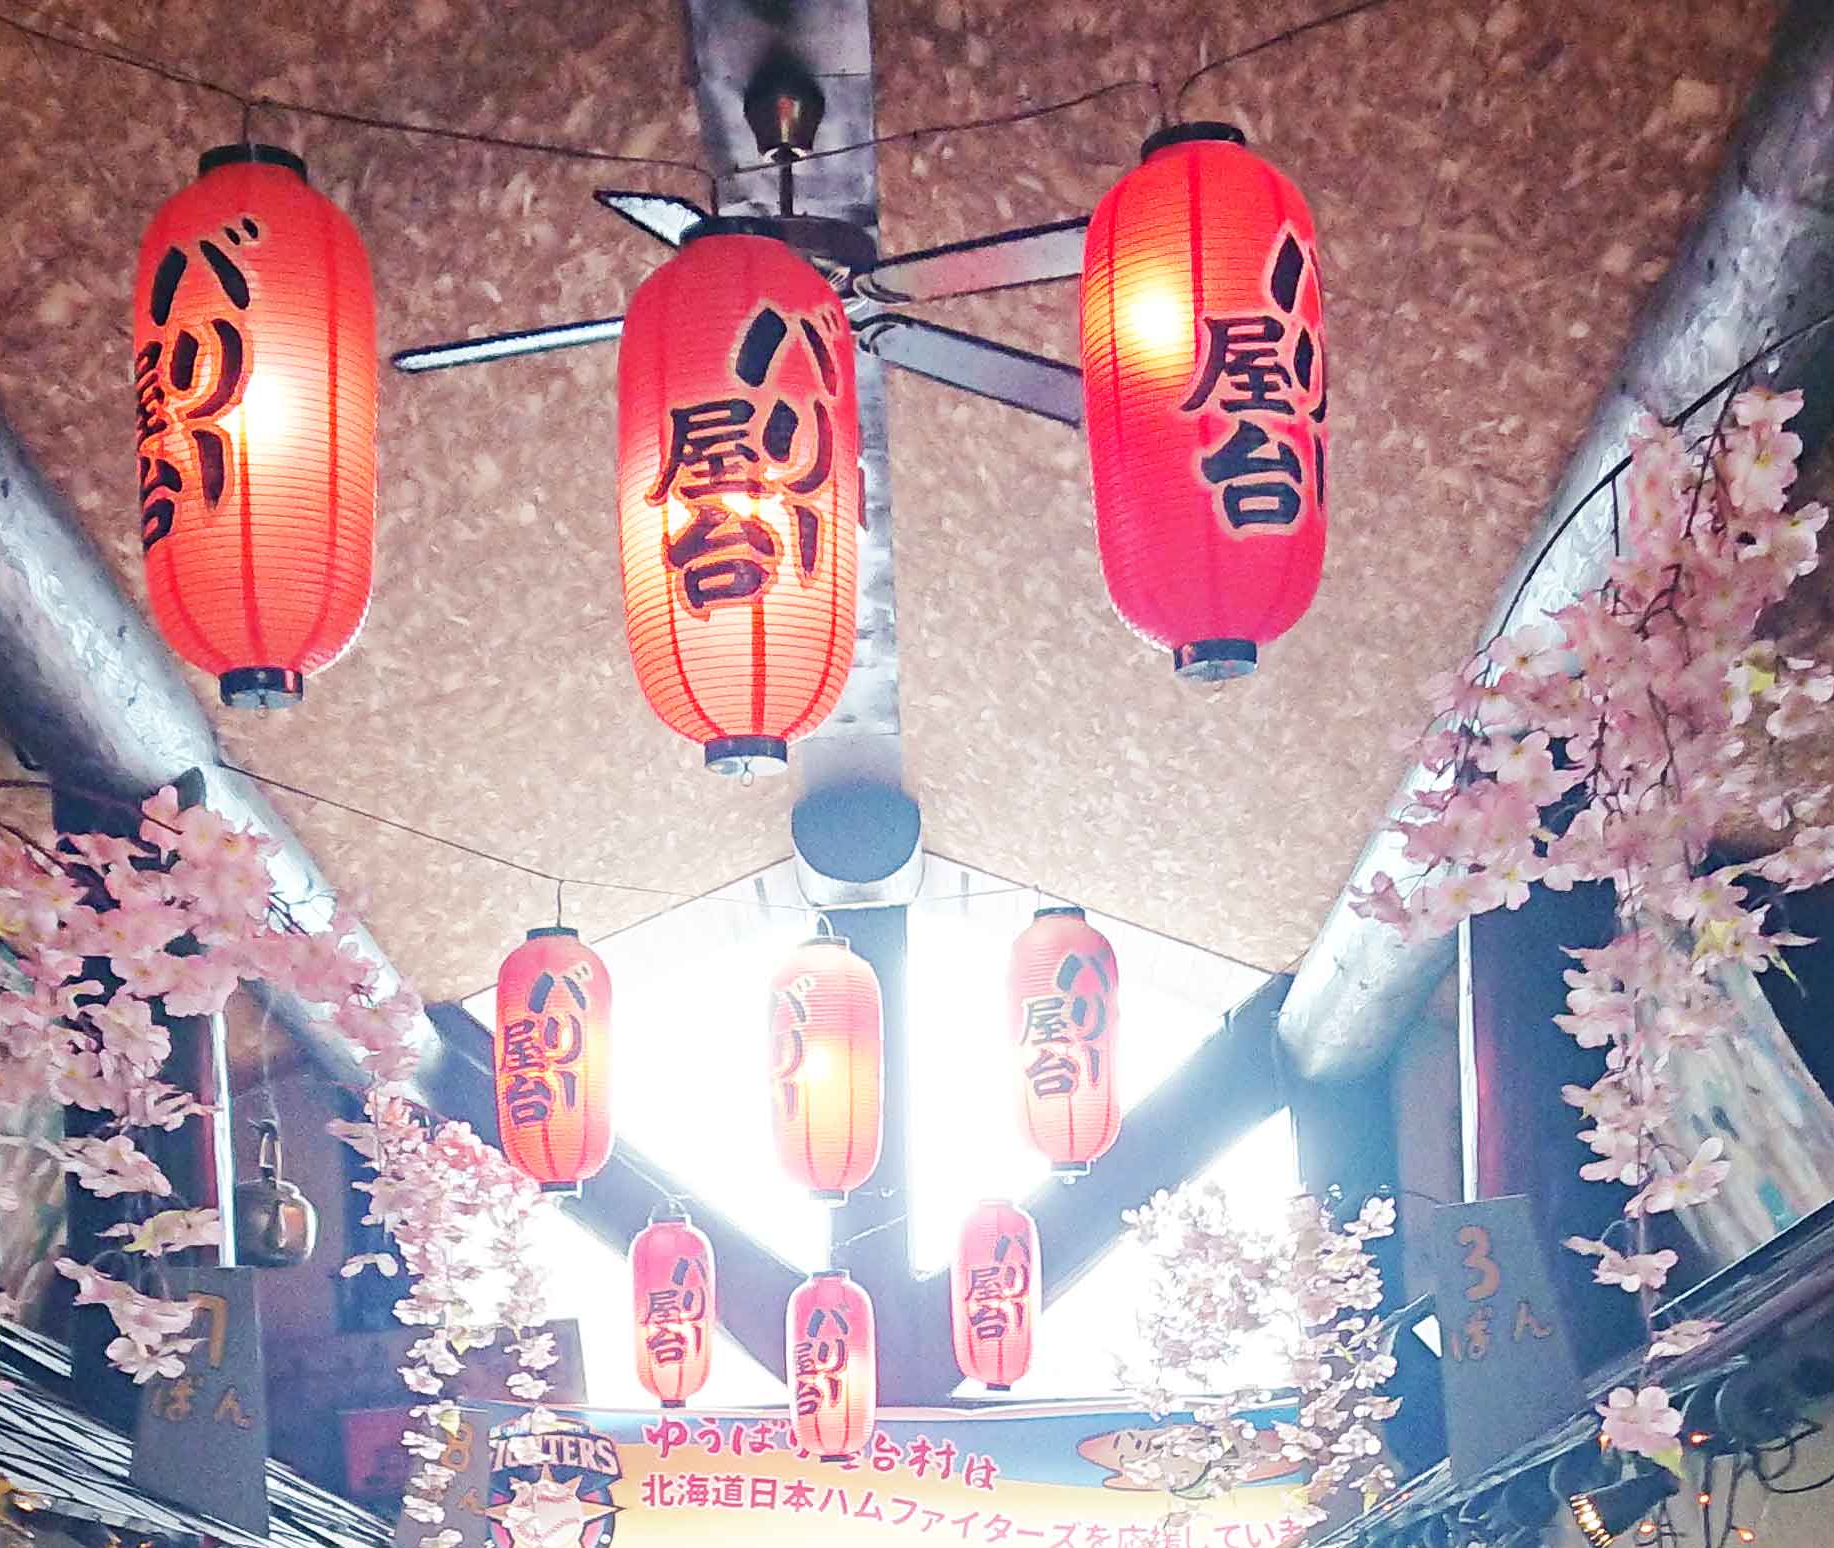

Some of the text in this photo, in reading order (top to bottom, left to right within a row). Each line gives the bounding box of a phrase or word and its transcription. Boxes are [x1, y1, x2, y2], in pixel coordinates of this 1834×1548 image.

[150, 217, 260, 511] バリー
[136, 340, 183, 553] 屋台
[735, 306, 841, 578] バリー
[1179, 314, 1303, 530] 屋台
[645, 398, 776, 610] 屋台
[527, 963, 590, 1111] バリー
[1019, 996, 1077, 1099] 屋台
[1055, 946, 1111, 1088] バリー
[500, 1018, 553, 1126] 屋台
[965, 1264, 1009, 1342] 屋台
[1457, 1224, 1501, 1301] 3
[639, 1289, 689, 1364] 屋台
[796, 1341, 822, 1417] 屋台
[806, 1300, 850, 1409] バリー
[643, 1416, 999, 1491] ゆうば台村は
